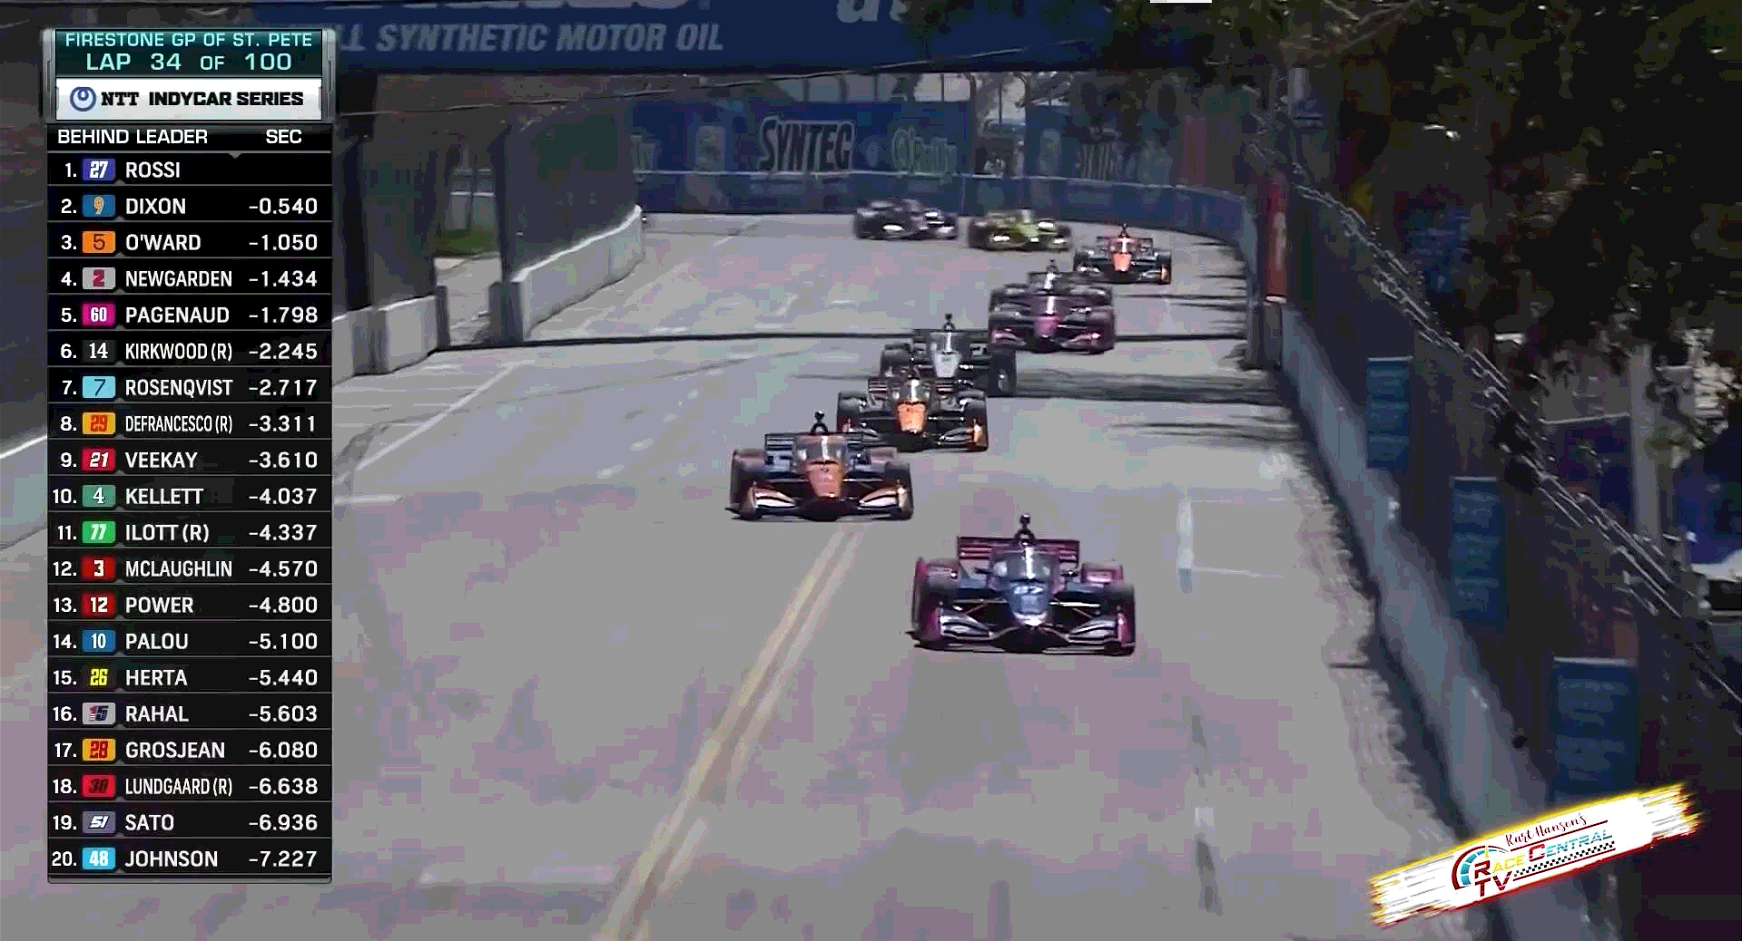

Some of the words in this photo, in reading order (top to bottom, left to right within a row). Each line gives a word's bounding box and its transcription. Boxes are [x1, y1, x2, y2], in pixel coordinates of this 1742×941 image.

[375, 24, 550, 51] SYNTHETIC
[555, 23, 667, 51] MOTOR
[675, 23, 723, 51] OIL
